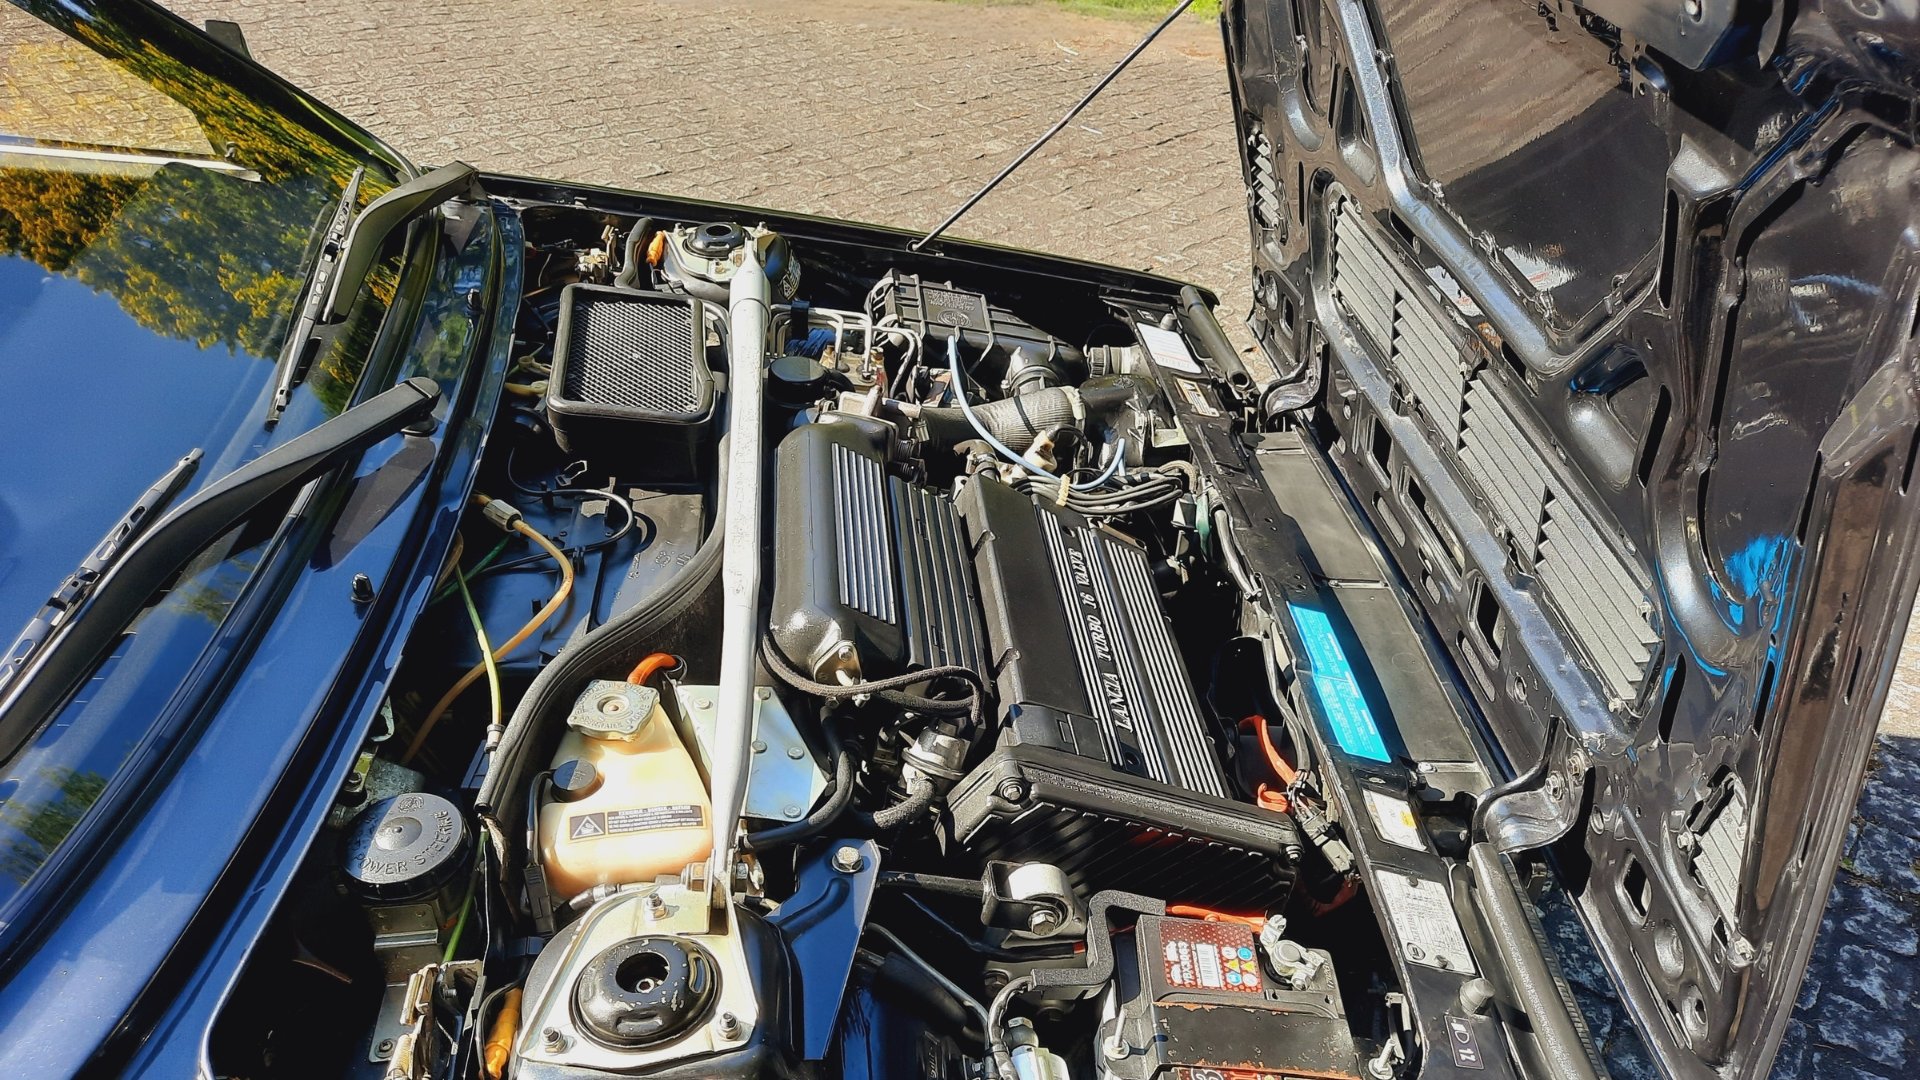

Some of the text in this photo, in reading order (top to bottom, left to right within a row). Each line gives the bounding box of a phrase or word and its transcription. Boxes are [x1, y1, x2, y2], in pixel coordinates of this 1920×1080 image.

[1068, 548, 1132, 732] LANCIA TURBO 16 VALVE
[354, 852, 407, 875] POWER
[414, 810, 453, 866] STEERING
